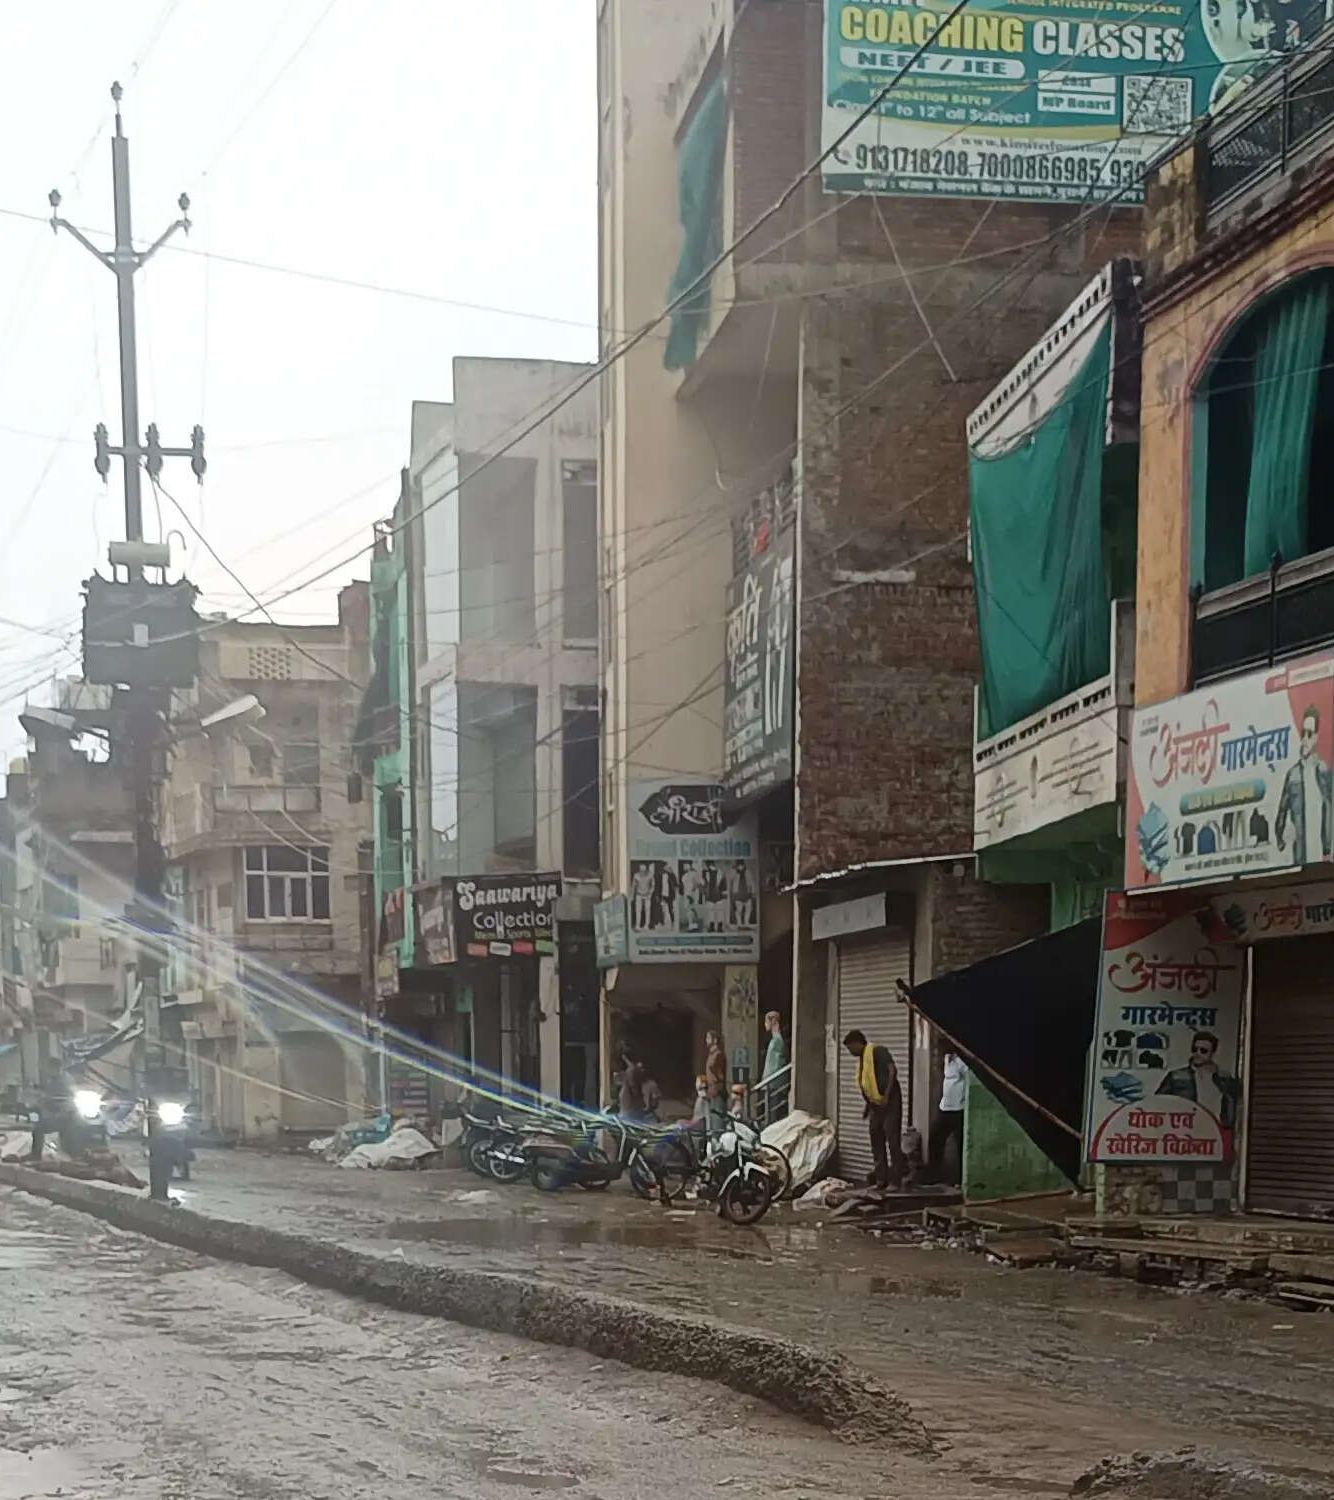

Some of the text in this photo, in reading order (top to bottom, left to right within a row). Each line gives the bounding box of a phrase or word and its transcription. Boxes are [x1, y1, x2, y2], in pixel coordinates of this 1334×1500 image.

[840, 6, 1185, 63] COACHING CLASSES
[857, 51, 930, 70] NEET
[961, 59, 1008, 76] JEE
[896, 103, 914, 117] to
[969, 108, 1031, 126] Subject
[1067, 97, 1111, 111] Board
[1149, 699, 1231, 789] अंजली
[1108, 947, 1236, 999] अंजली
